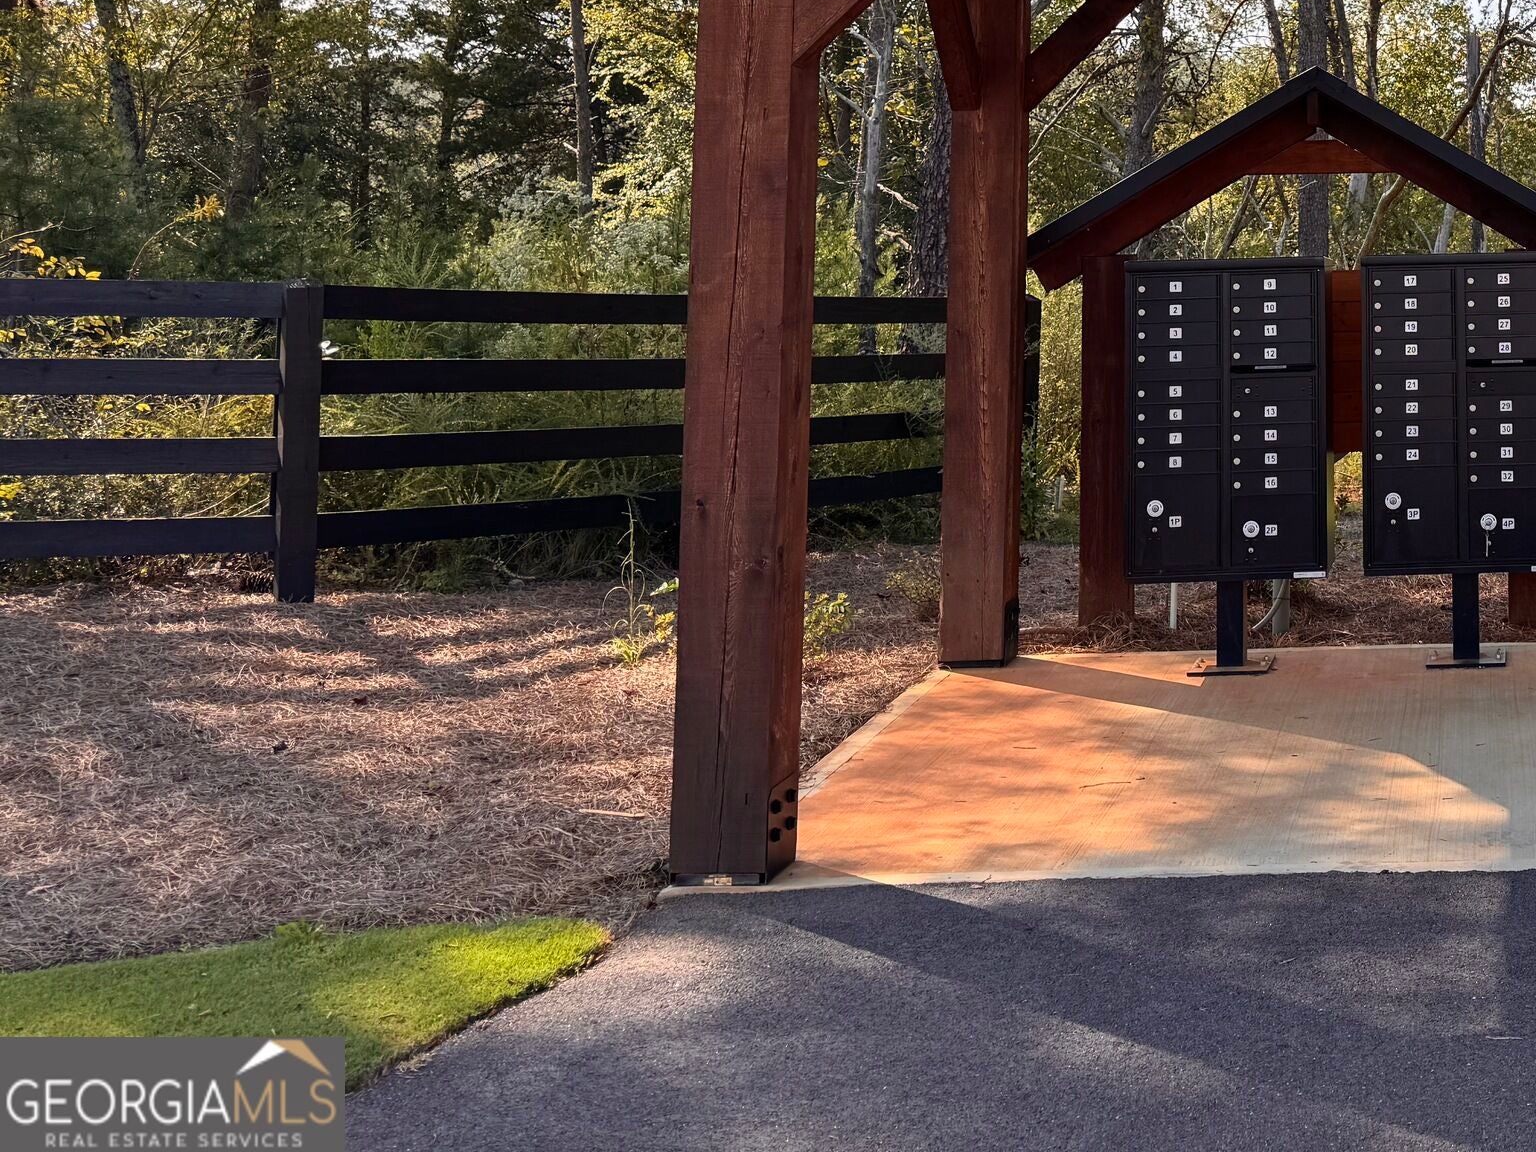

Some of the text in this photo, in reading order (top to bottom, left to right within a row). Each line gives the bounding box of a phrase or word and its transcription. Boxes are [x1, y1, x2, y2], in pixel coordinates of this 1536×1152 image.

[1499, 298, 1509, 306] 26
[1499, 321, 1509, 329] 27
[1266, 350, 1275, 358] 12
[1407, 346, 1417, 354] 20
[1407, 381, 1416, 389] 21
[1266, 408, 1276, 416] 13
[1407, 404, 1417, 412] 22
[1407, 427, 1417, 435] 23
[1502, 425, 1511, 433] 30
[1266, 431, 1276, 439] 14
[1408, 451, 1418, 459] 24
[1502, 448, 1511, 457] 31
[1266, 454, 1276, 463] 15
[1502, 472, 1513, 480] 32
[1266, 478, 1276, 487] 16
[1408, 510, 1419, 518] 3P
[1170, 518, 1181, 526] 1P
[1503, 519, 1514, 528] 4P
[1266, 526, 1277, 535] 2P
